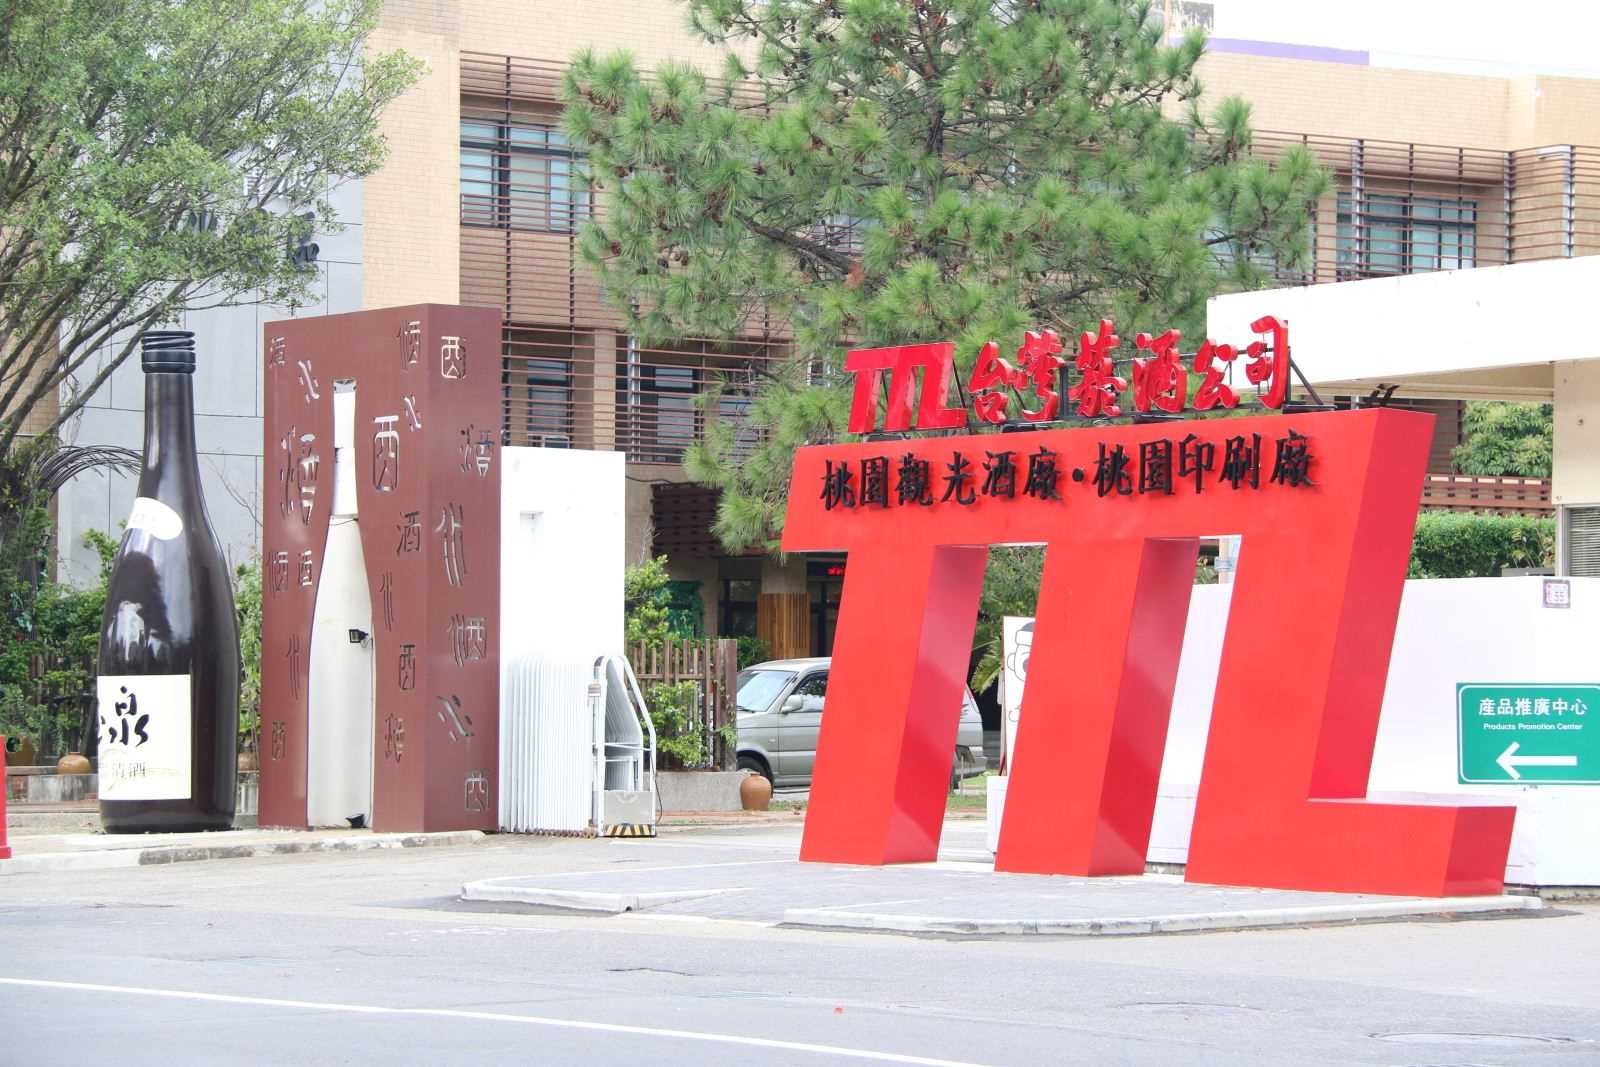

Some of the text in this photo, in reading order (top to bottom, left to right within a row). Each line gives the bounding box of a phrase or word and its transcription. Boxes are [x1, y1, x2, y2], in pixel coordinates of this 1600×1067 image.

[843, 342, 969, 432] TTL
[1483, 722, 1583, 731] Products Promotion Center
